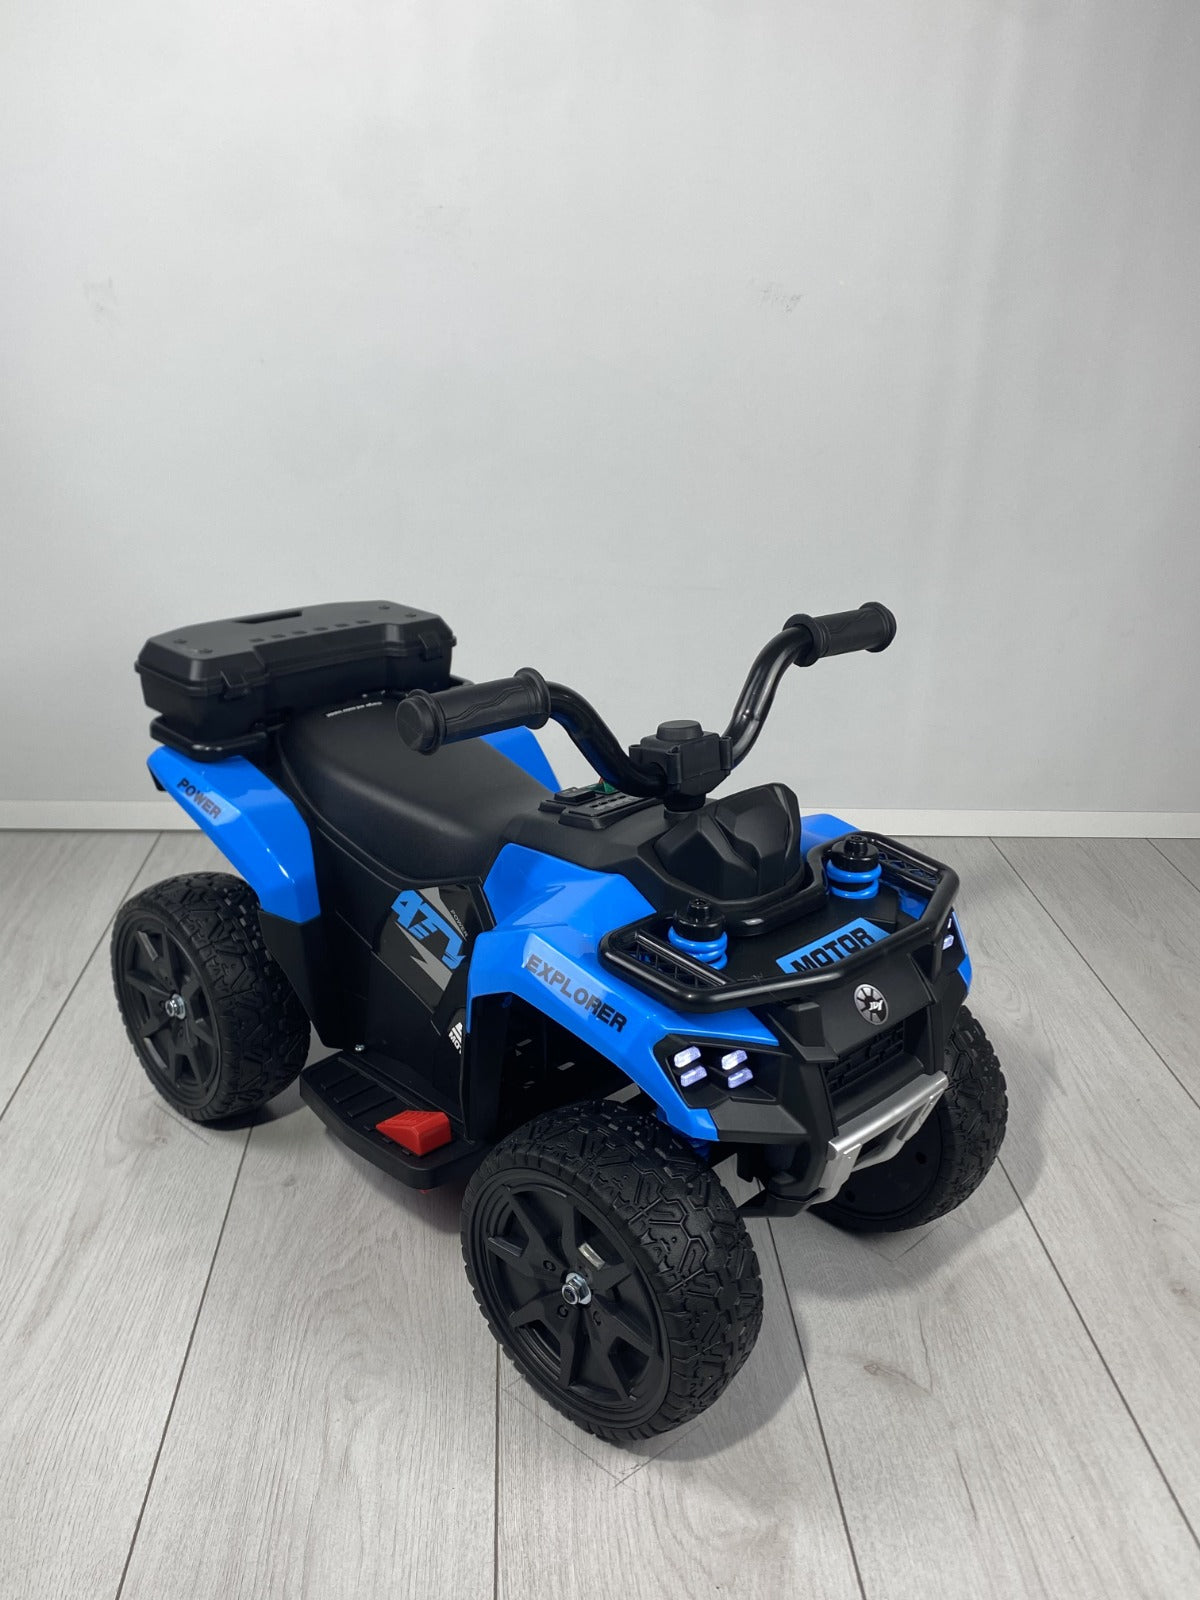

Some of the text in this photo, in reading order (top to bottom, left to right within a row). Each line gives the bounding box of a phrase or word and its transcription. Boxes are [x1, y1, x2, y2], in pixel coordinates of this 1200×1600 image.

[177, 777, 222, 820] POWER
[450, 909, 469, 937] POWER
[790, 927, 876, 972] MOTOR
[525, 953, 628, 1033] EXPLORER
